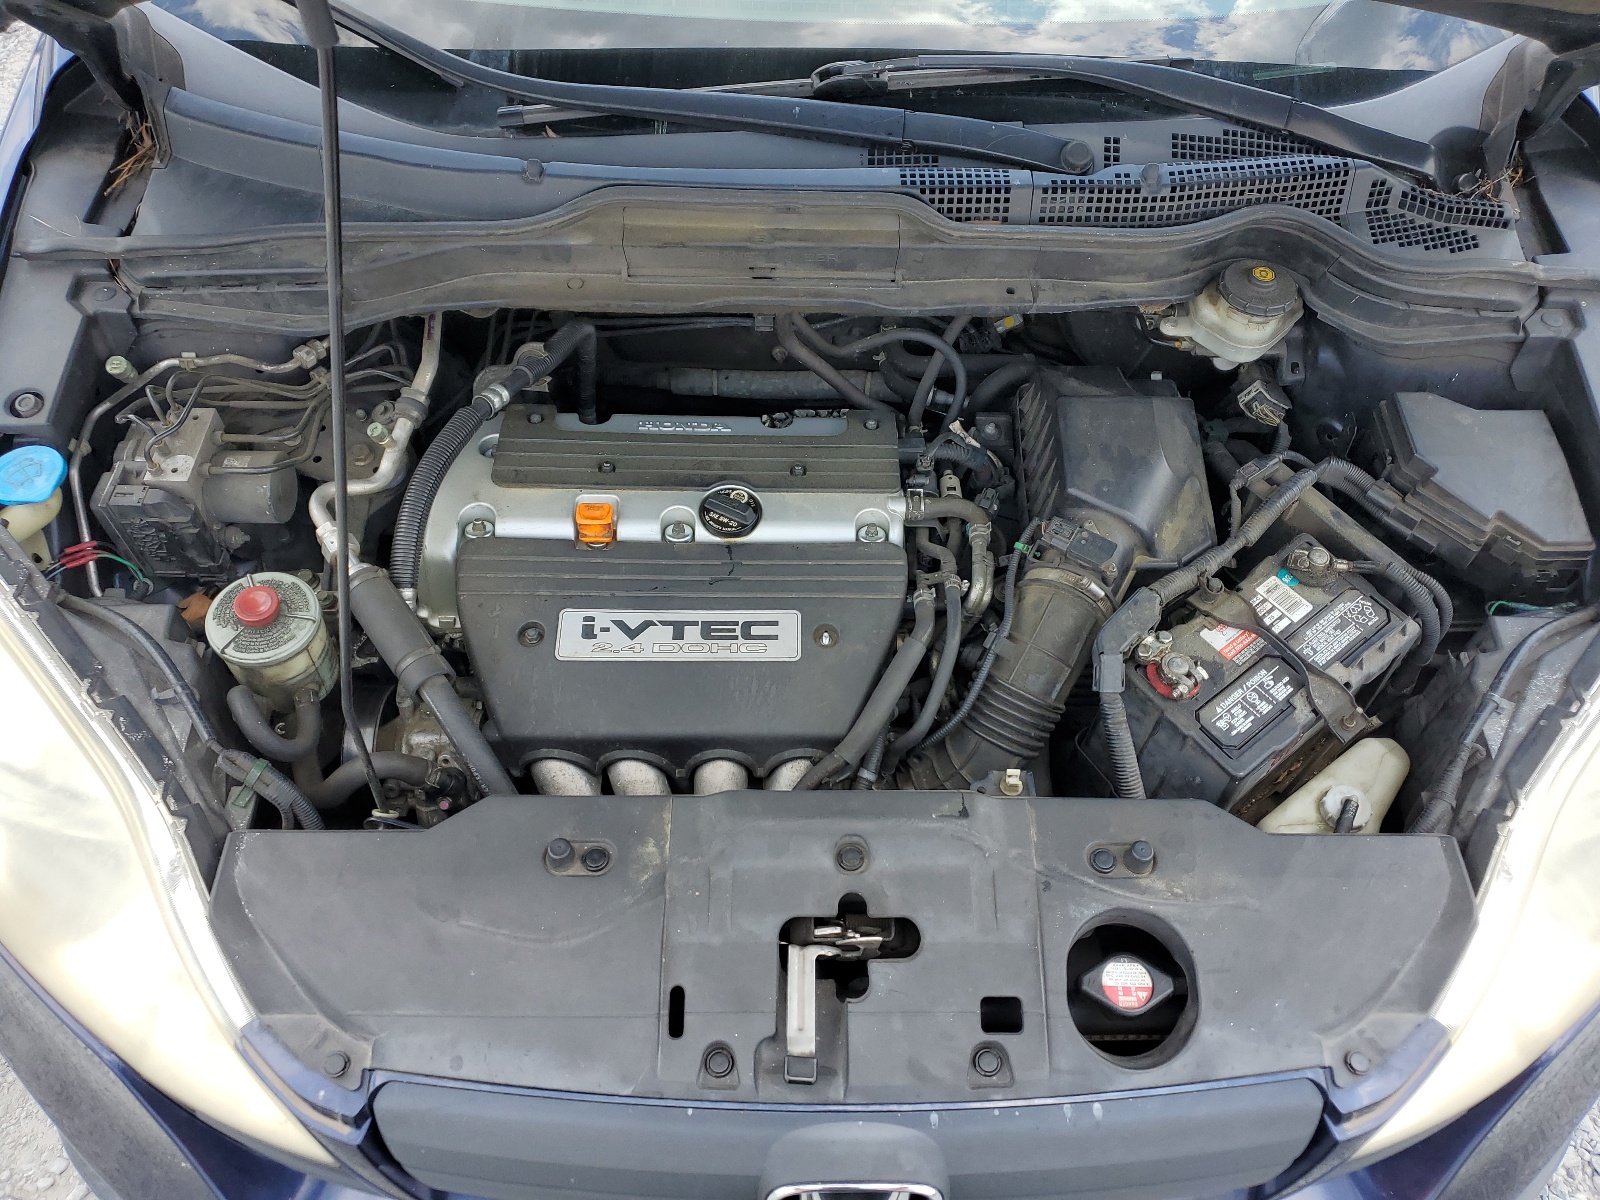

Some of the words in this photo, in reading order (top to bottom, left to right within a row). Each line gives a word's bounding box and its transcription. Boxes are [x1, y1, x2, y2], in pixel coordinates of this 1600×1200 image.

[638, 421, 732, 432] HONDA
[708, 511, 720, 520] SAE
[719, 516, 738, 527] 5W-20
[581, 615, 779, 641] i-VTEC
[591, 642, 645, 654] 2.4
[652, 642, 768, 654] DOHC
[1219, 688, 1244, 709] DANGER
